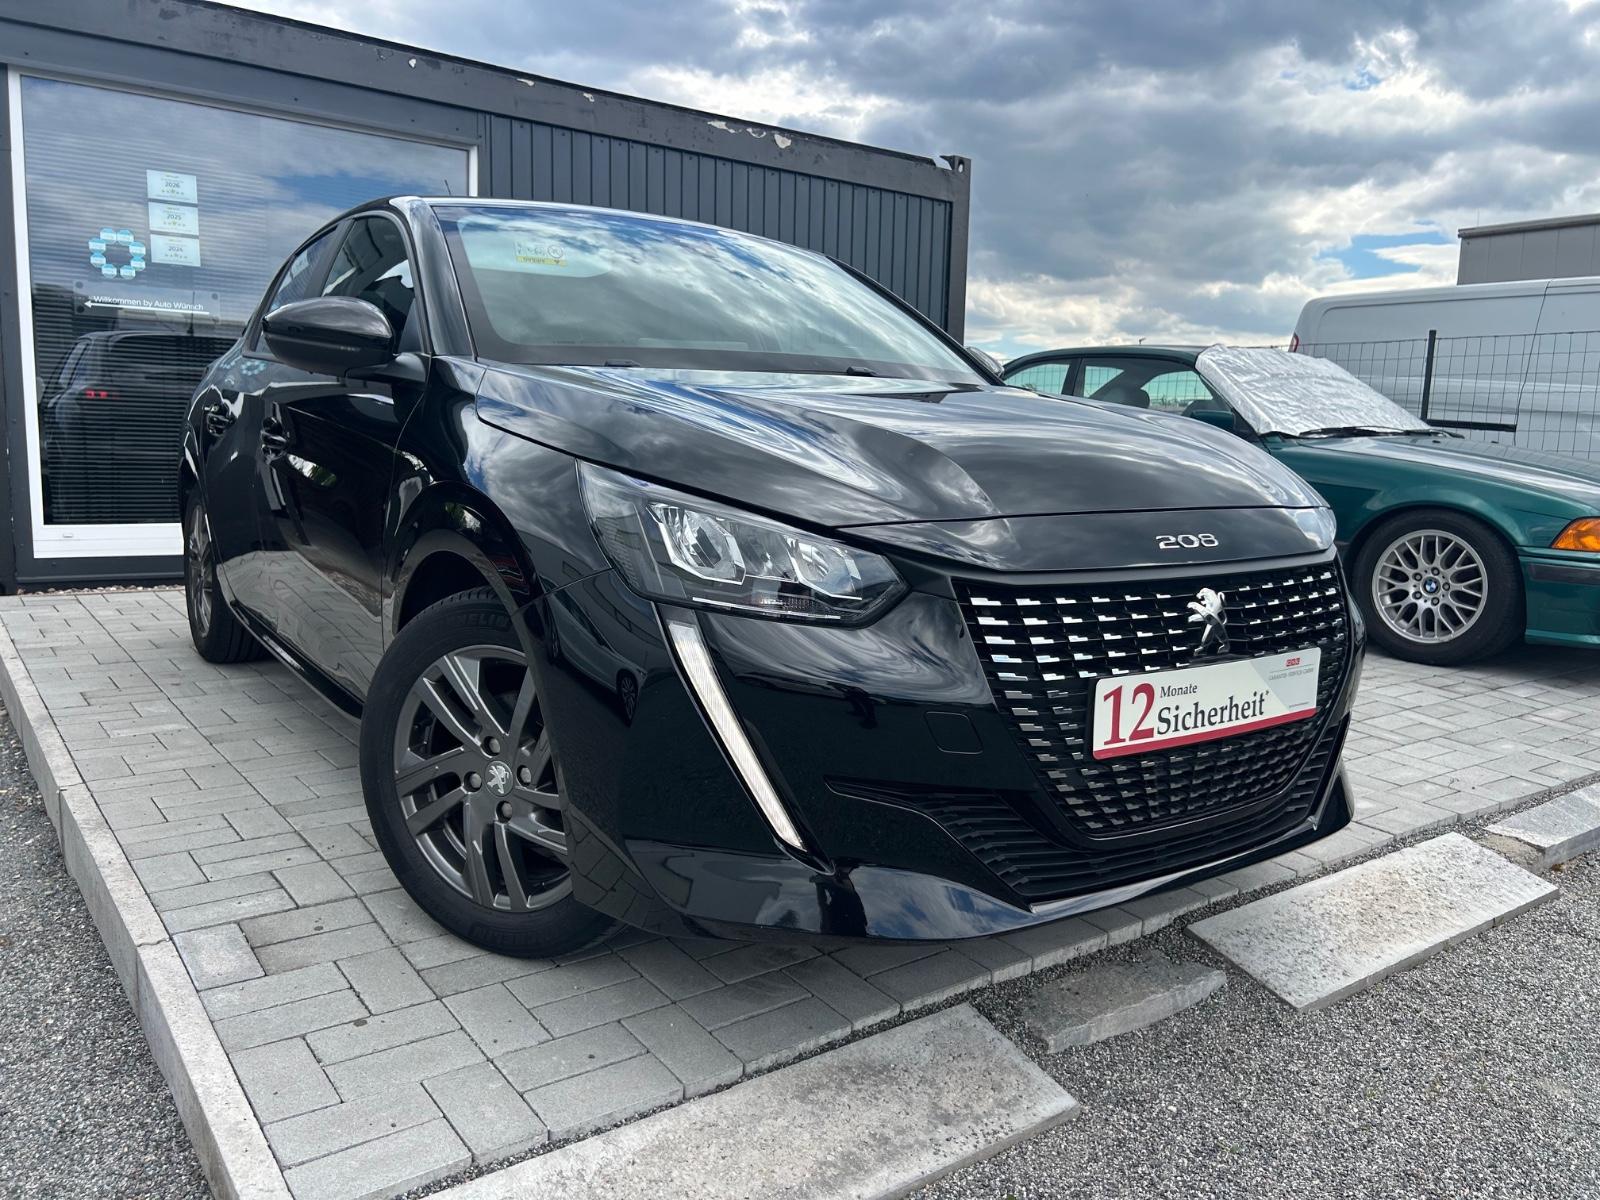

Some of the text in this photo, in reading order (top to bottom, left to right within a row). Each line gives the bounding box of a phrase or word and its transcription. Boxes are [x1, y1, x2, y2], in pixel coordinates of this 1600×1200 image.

[93, 295, 141, 306] Willkommen
[143, 299, 152, 309] by
[154, 300, 172, 309] Auto
[1155, 533, 1219, 549] 208
[1160, 683, 1198, 698] Monate
[1103, 683, 1155, 746] 12
